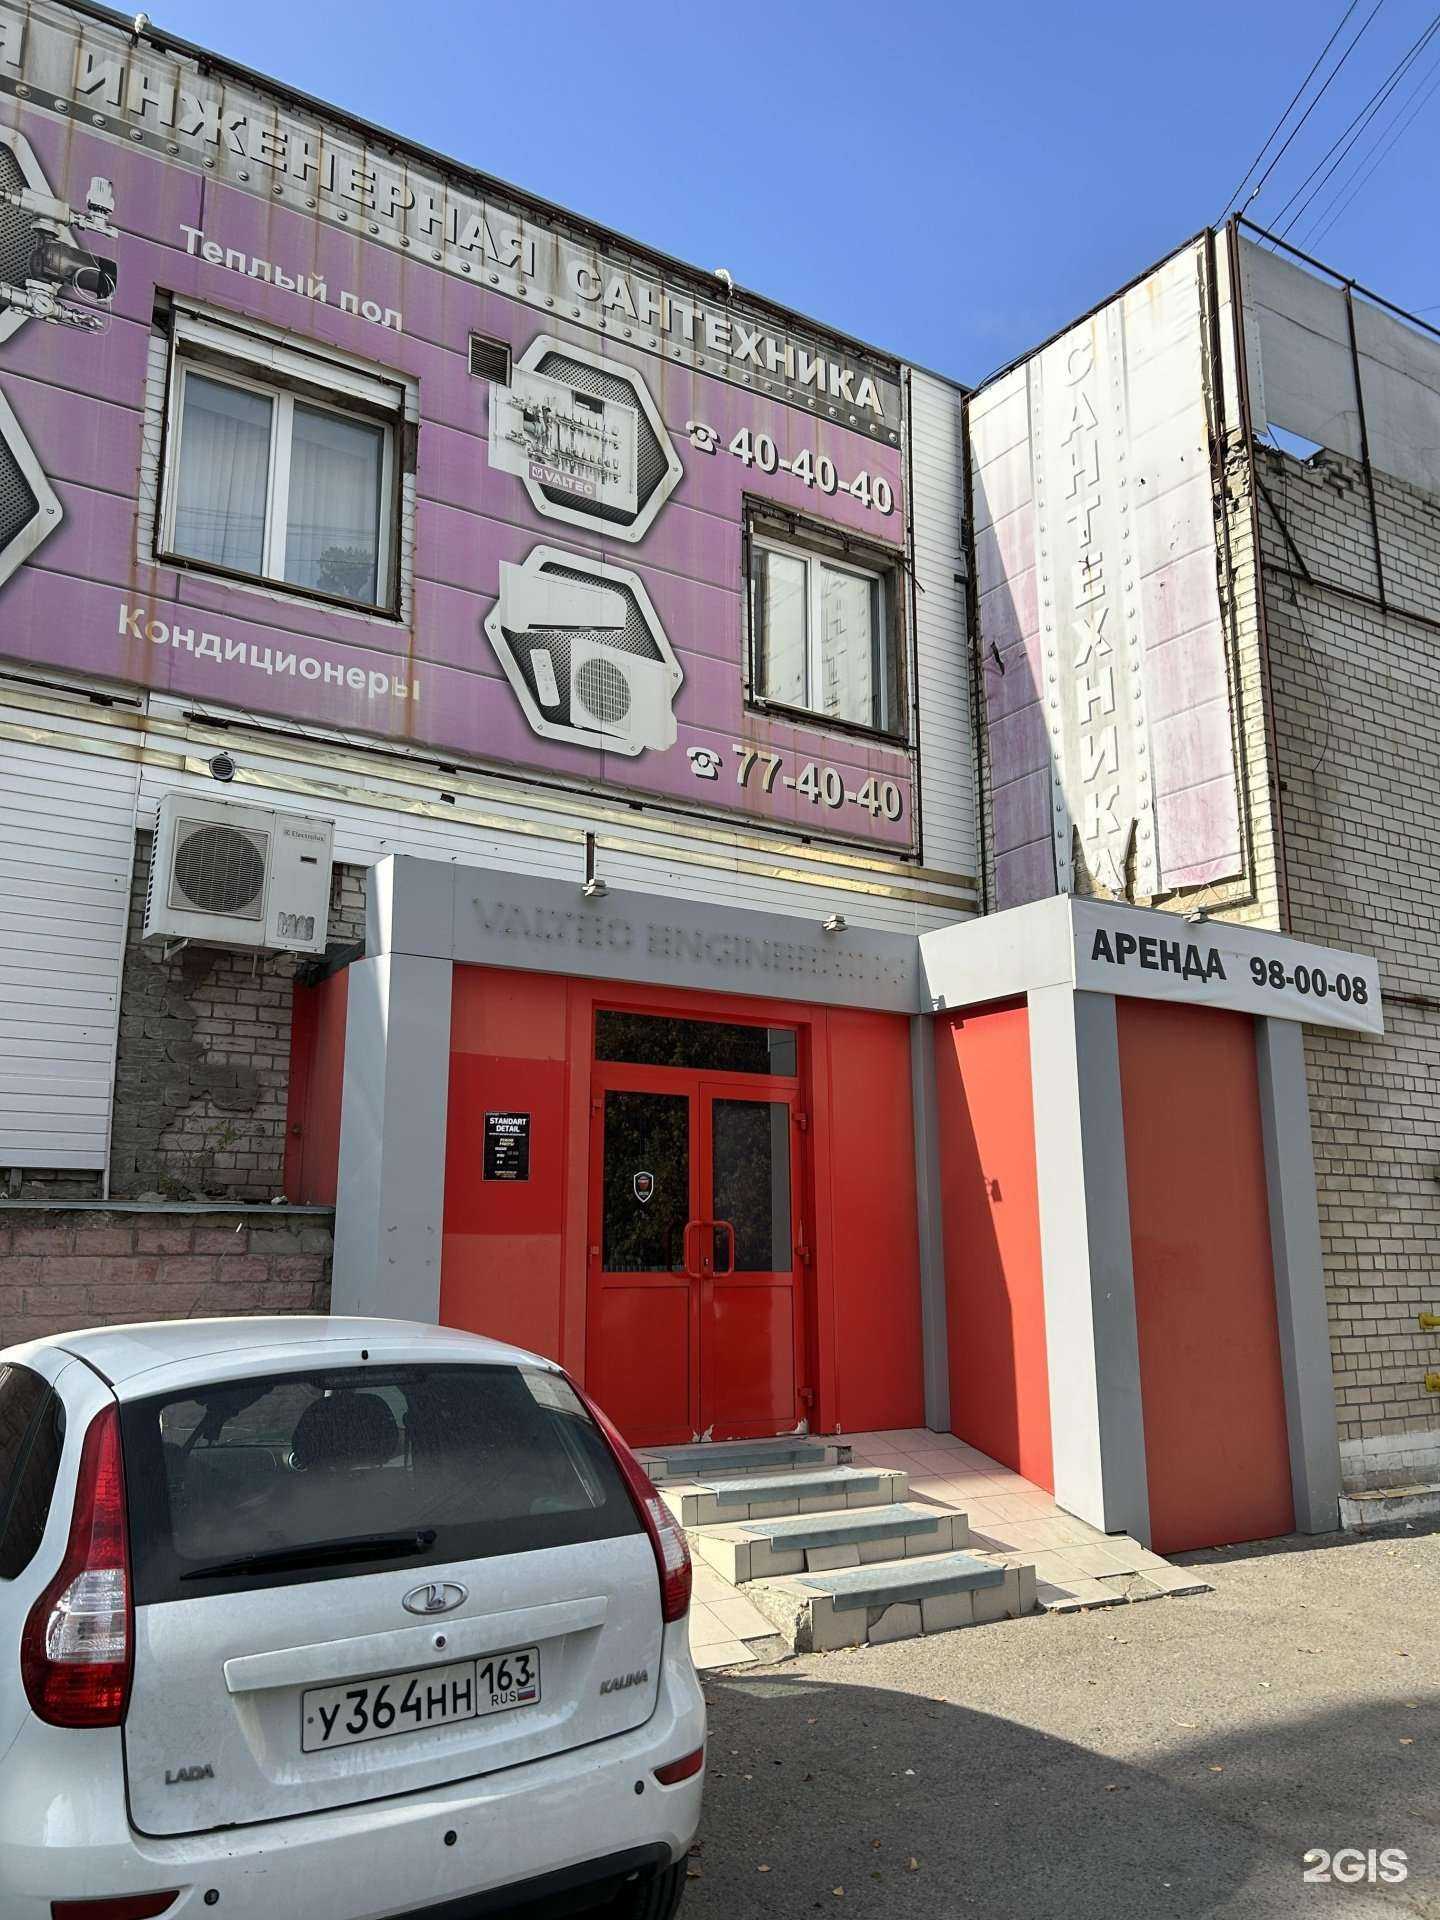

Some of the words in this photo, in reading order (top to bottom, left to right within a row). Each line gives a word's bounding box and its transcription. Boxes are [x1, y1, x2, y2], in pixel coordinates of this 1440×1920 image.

[73, 46, 535, 277] ИНЖЕНЕРНАЯ
[567, 258, 884, 416] САНТЕХНИКА
[180, 223, 327, 304] Теплый
[340, 289, 403, 332] пол
[544, 470, 594, 495] VALTEC
[729, 427, 895, 515] 40-40-40
[117, 602, 421, 701] Кондиционеры
[732, 743, 903, 822] 77-40-40
[1091, 928, 1228, 983] АРЕНДА
[1249, 956, 1369, 1005] 98-00-08
[489, 1117, 527, 1125] STANDART
[495, 1124, 520, 1132] DETAIL
[479, 1654, 531, 1694] 163
[599, 1669, 649, 1696] KALINA
[490, 1691, 518, 1706] RUS
[164, 1763, 215, 1785] LADA
